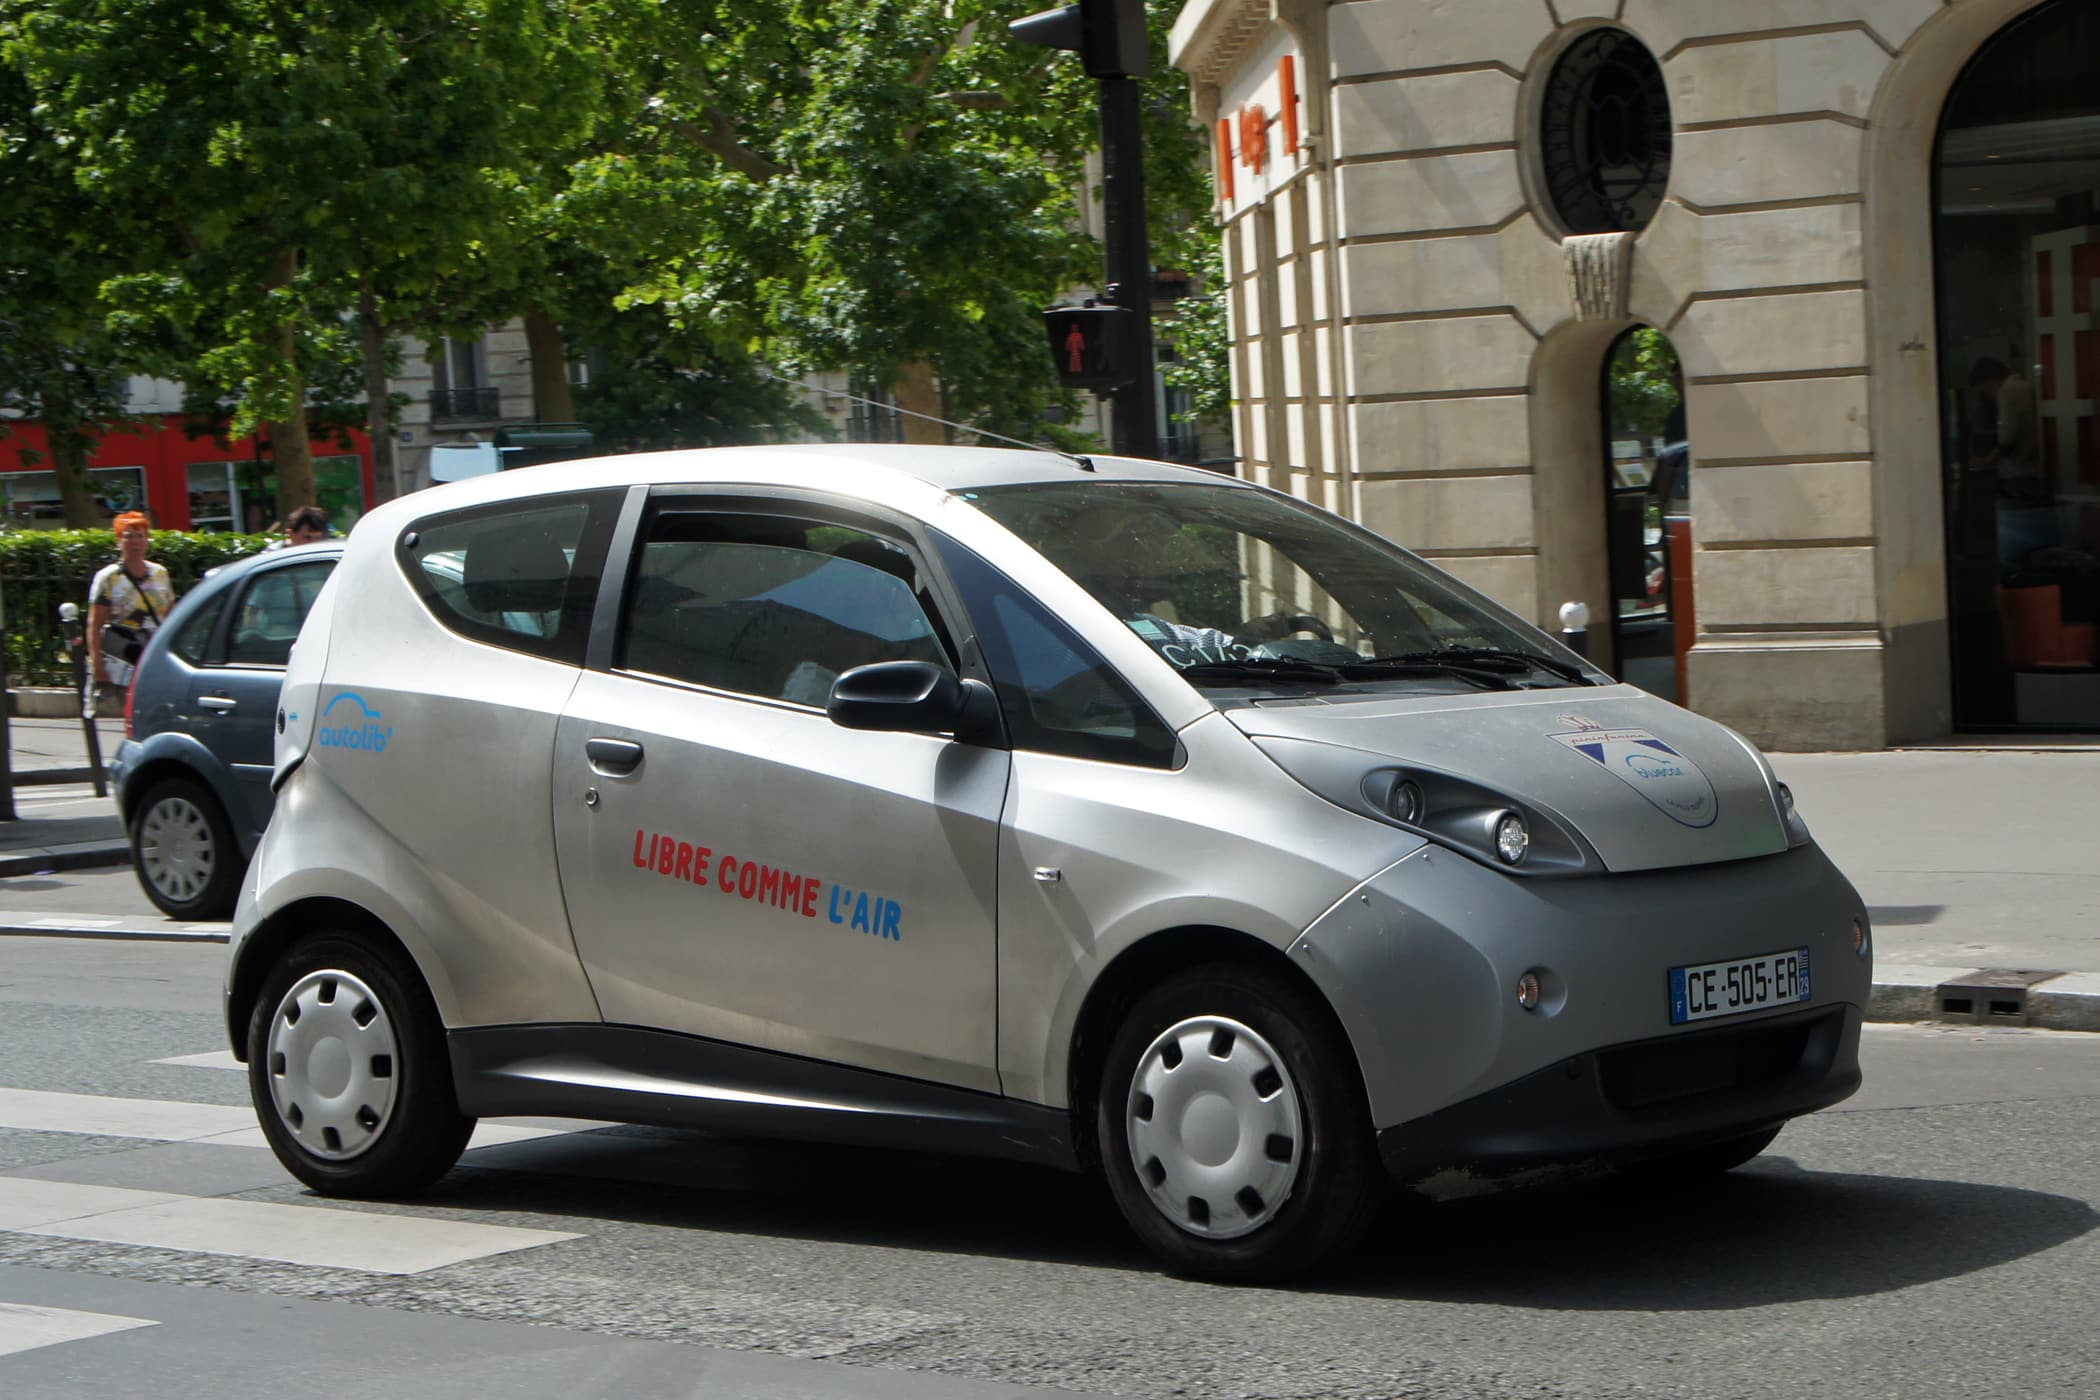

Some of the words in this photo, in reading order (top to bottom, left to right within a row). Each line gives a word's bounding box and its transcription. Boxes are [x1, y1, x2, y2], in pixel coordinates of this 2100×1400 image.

[633, 829, 712, 886] LIBRE
[718, 855, 821, 917] COMME
[829, 884, 902, 942] L'AIR
[1676, 1000, 1683, 1013] F
